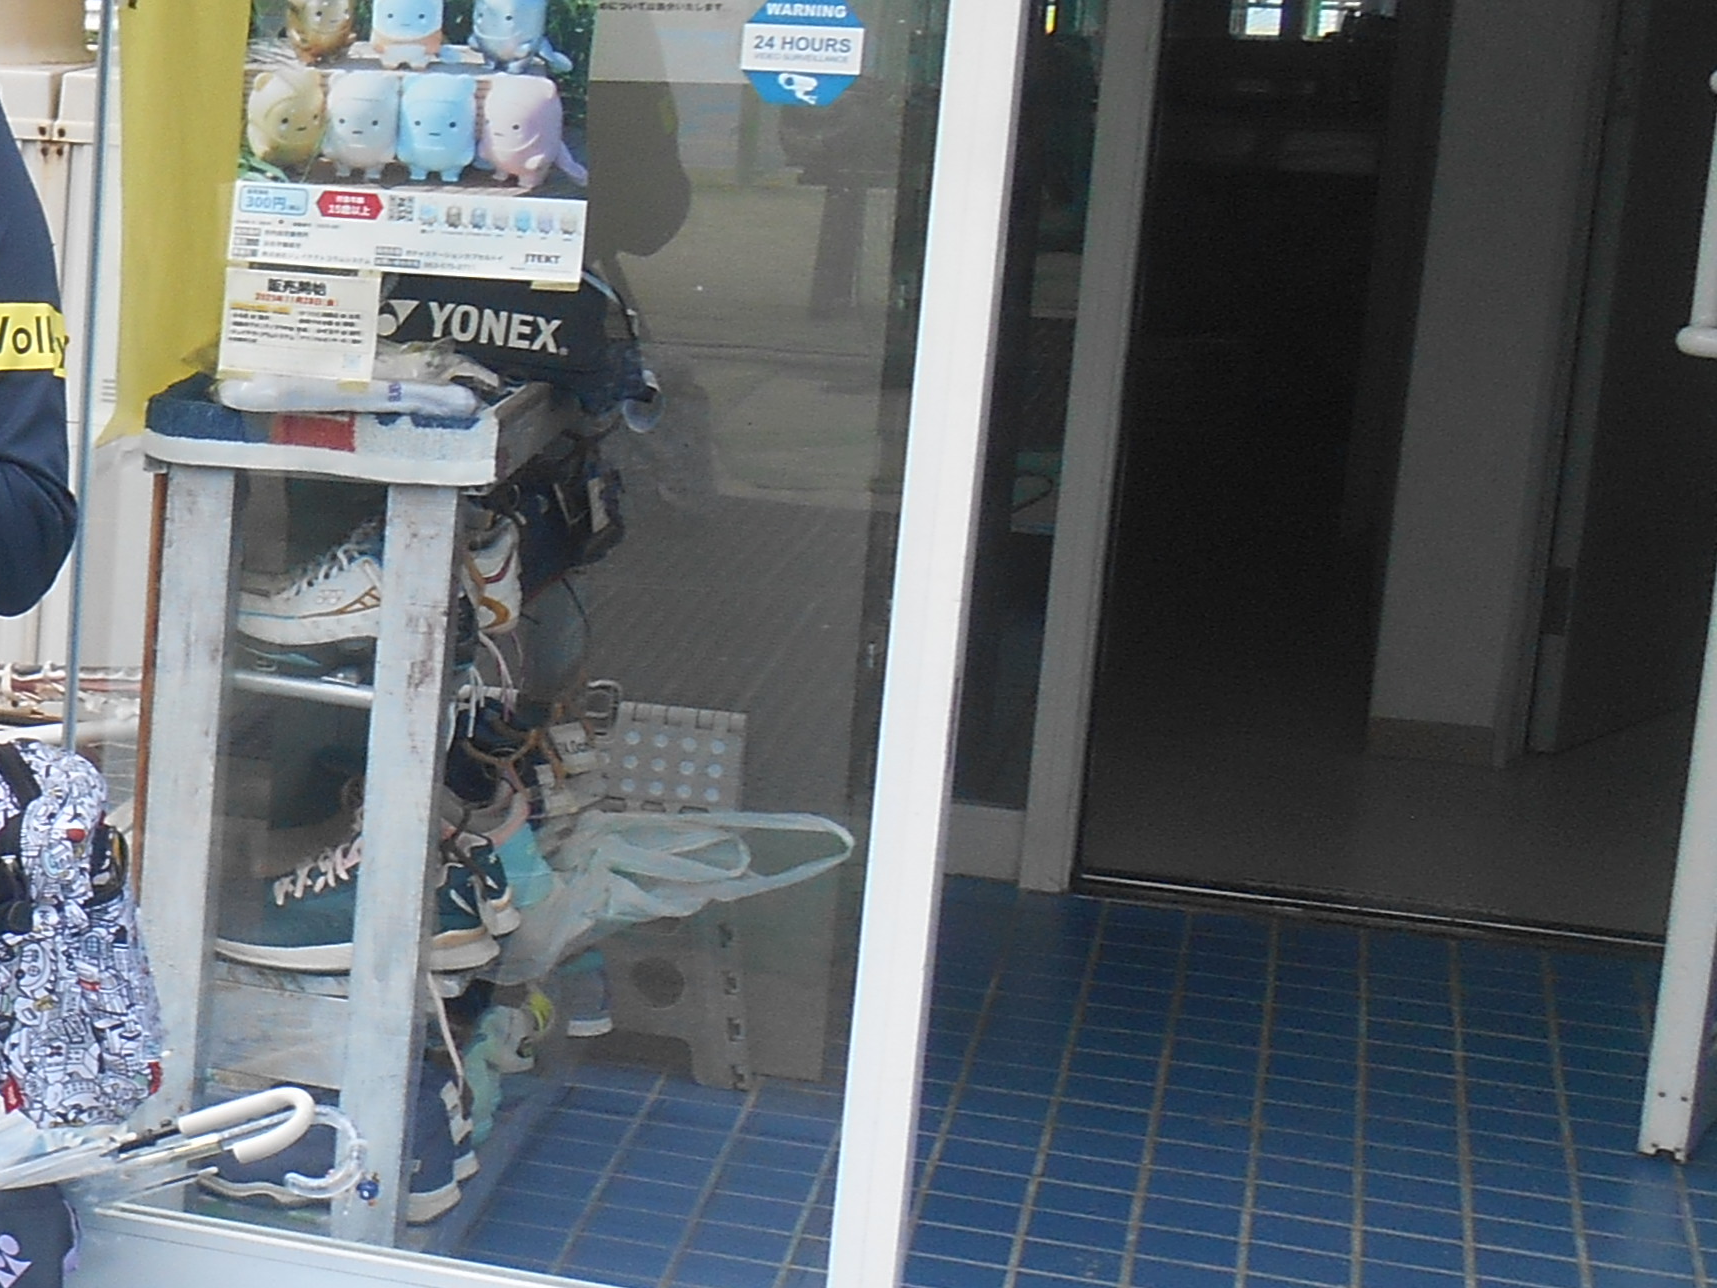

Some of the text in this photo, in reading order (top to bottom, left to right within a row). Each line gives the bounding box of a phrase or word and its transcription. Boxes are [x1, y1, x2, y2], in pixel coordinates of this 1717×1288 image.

[766, 2, 847, 19] WARNING
[753, 34, 852, 54] 24 HOURS
[524, 253, 562, 264] JTEKT
[428, 301, 563, 354] YONEX
